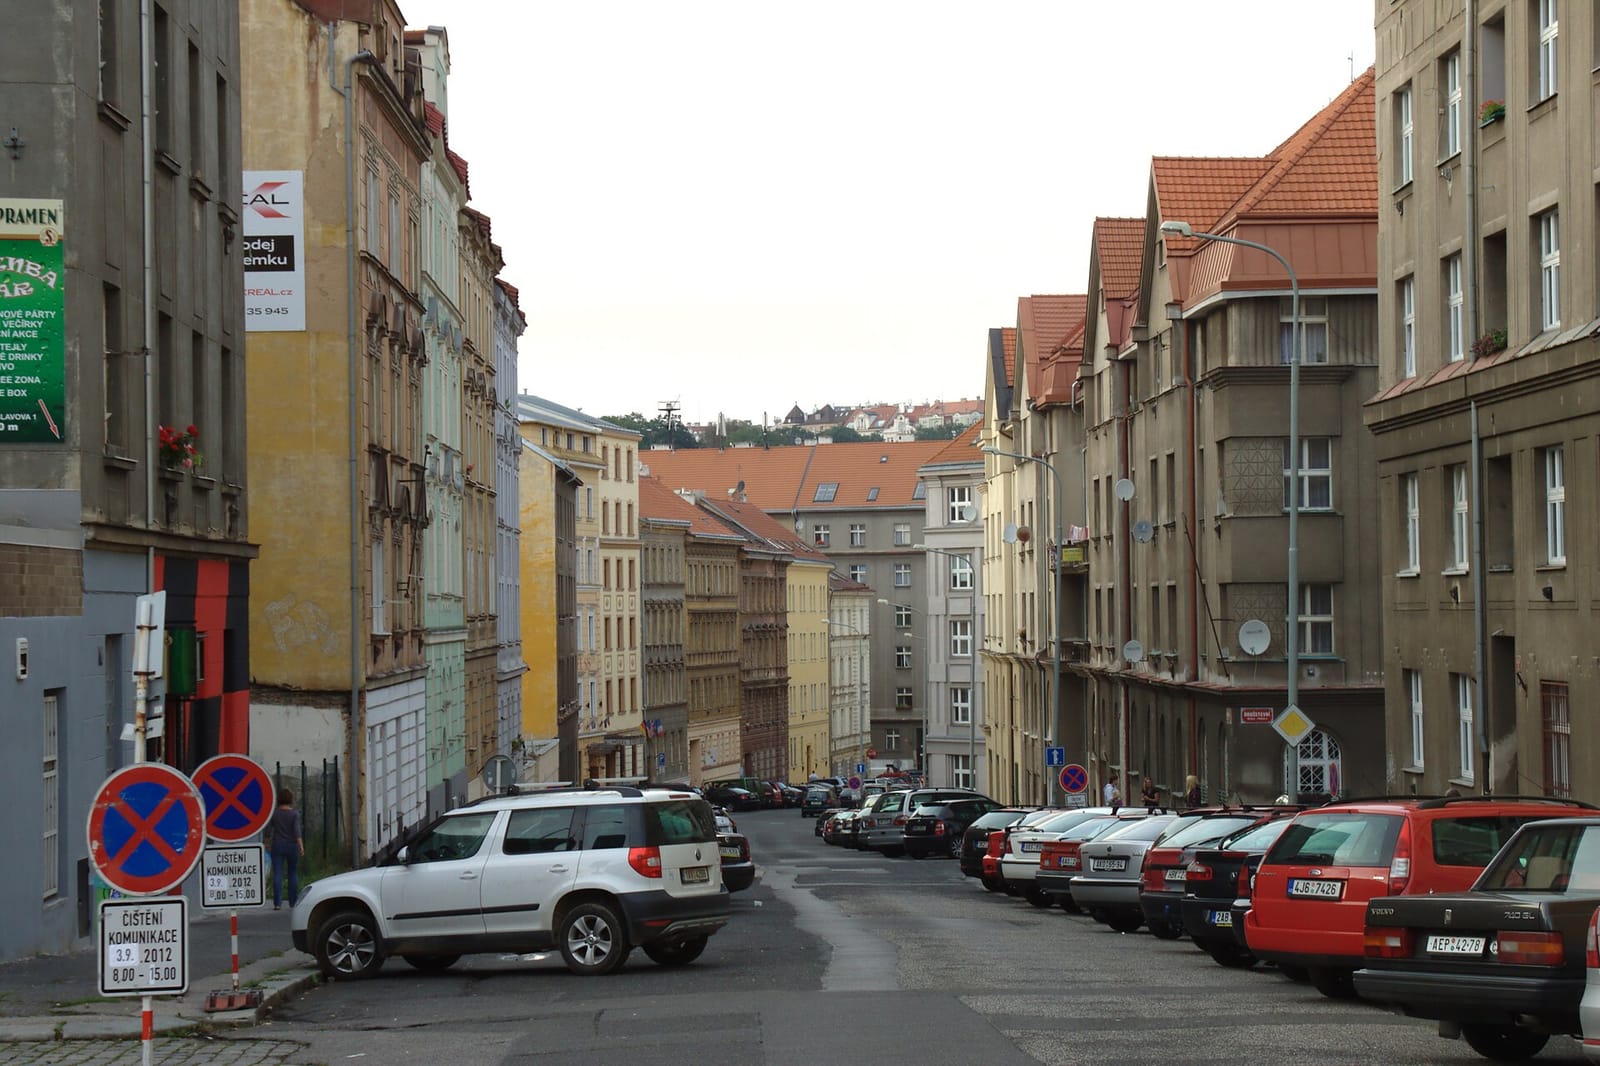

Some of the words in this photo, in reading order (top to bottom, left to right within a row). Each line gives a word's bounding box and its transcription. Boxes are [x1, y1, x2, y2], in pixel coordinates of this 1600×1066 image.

[243, 254, 288, 265] emku
[25, 308, 56, 319] PÁRTY
[247, 307, 263, 315] 35
[265, 307, 289, 315] 945
[2, 319, 43, 328] VEČÍRKY
[12, 330, 38, 338] AKCE
[8, 353, 43, 361] DRINKY
[14, 375, 41, 384] ZONA
[7, 388, 27, 396] BOX
[215, 850, 247, 864] ČIŠTĚNÍ
[206, 864, 257, 876] KOMUNIKACE
[1294, 882, 1310, 894] 4J6
[1314, 883, 1337, 895] 7426
[122, 908, 164, 927] ČIŠTĚNÍ
[1371, 908, 1395, 916] VOLVO
[1504, 911, 1521, 919] 740
[1522, 911, 1535, 920] GL
[108, 929, 178, 945] KOMUNIKACE
[1431, 938, 1450, 951] AEP
[116, 948, 135, 962] 3.9.
[150, 966, 177, 981] 15.00
